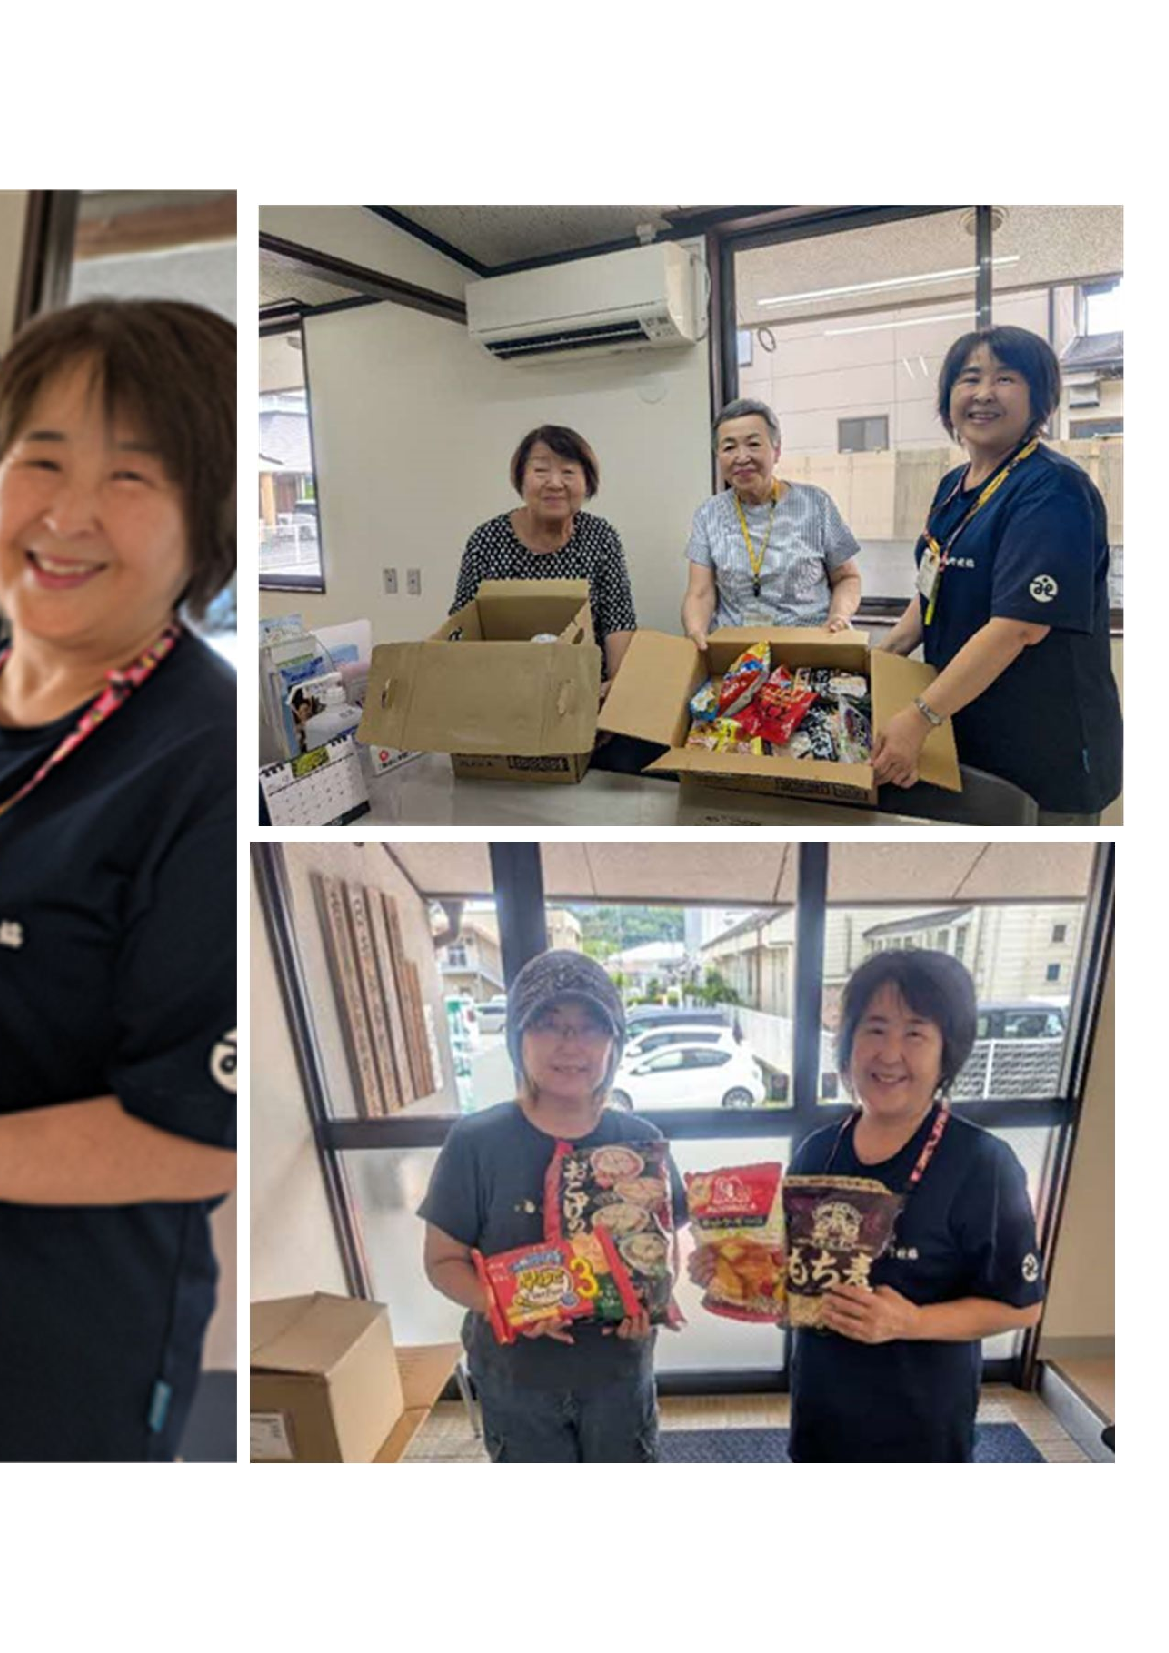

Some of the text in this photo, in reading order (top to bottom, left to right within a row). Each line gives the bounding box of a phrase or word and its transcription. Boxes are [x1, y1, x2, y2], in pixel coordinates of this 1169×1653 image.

[569, 1256, 600, 1299] 3
[788, 1246, 874, 1293] もち麦
